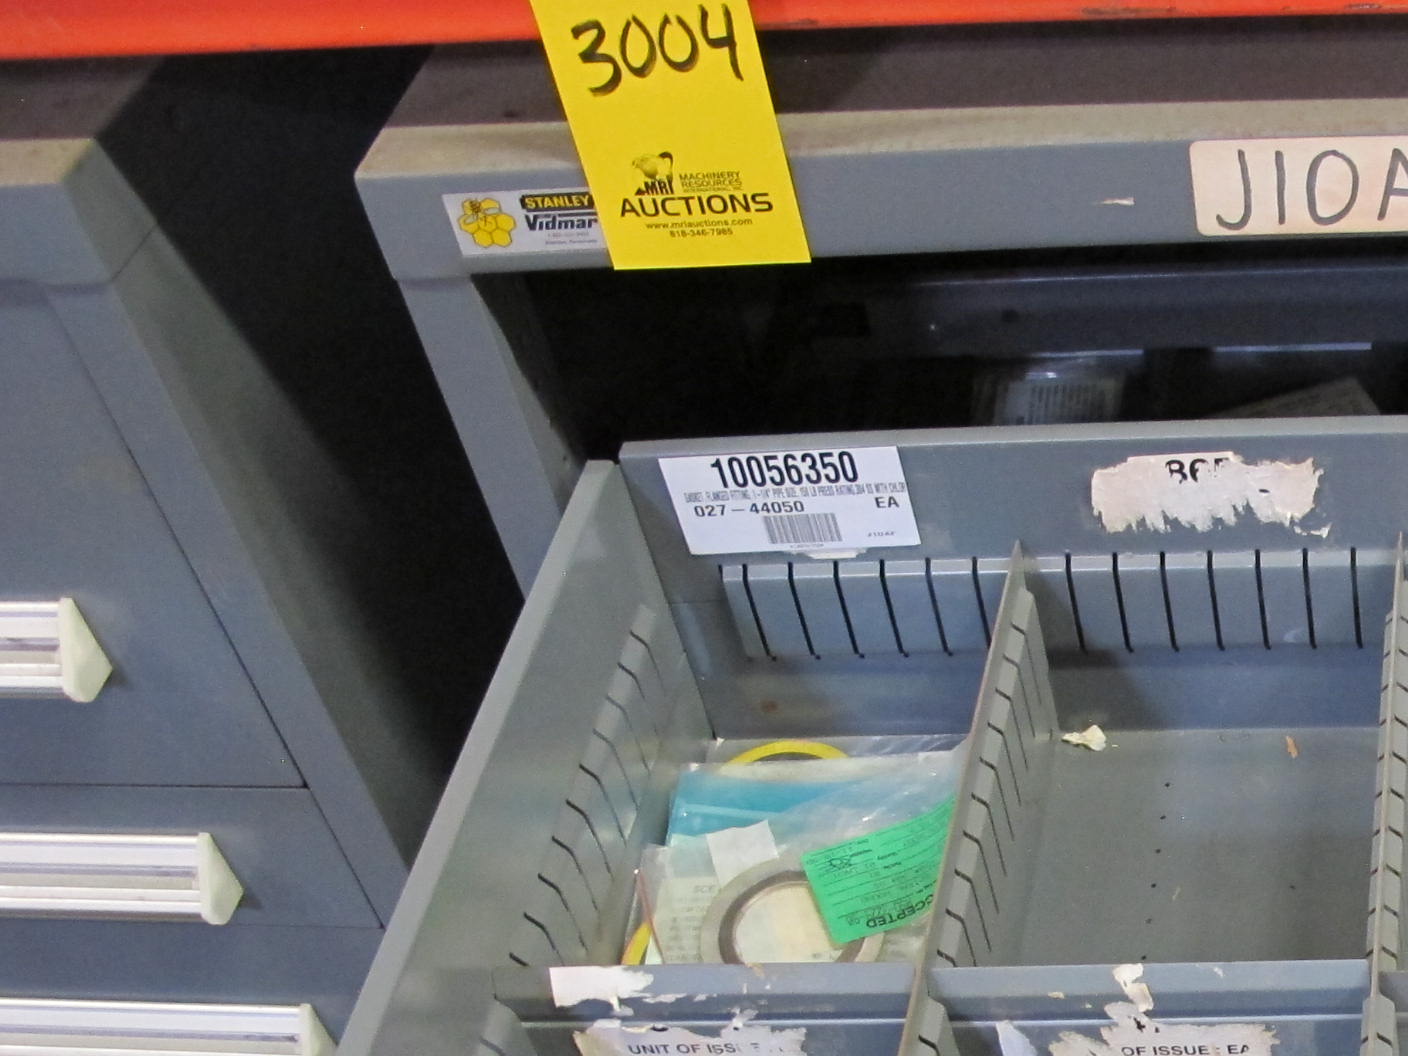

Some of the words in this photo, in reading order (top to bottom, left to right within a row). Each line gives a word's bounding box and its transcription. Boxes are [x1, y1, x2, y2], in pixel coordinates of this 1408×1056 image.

[570, 3, 744, 97] 3004
[679, 171, 740, 181] MACHINERY
[681, 178, 743, 188] RESOURCES
[525, 195, 589, 209] STANLEY
[620, 192, 774, 218] AUCTIONS
[525, 214, 597, 231] Vidmar
[645, 218, 753, 230] www.mriauctions.com
[710, 451, 859, 489] 10056350
[874, 496, 900, 509] EA
[866, 893, 934, 928] CCEPTED
[628, 1043, 670, 1056] UNIT
[676, 1043, 702, 1055] OF
[1122, 1046, 1147, 1056] OF
[1153, 1045, 1210, 1056] ISSUE
